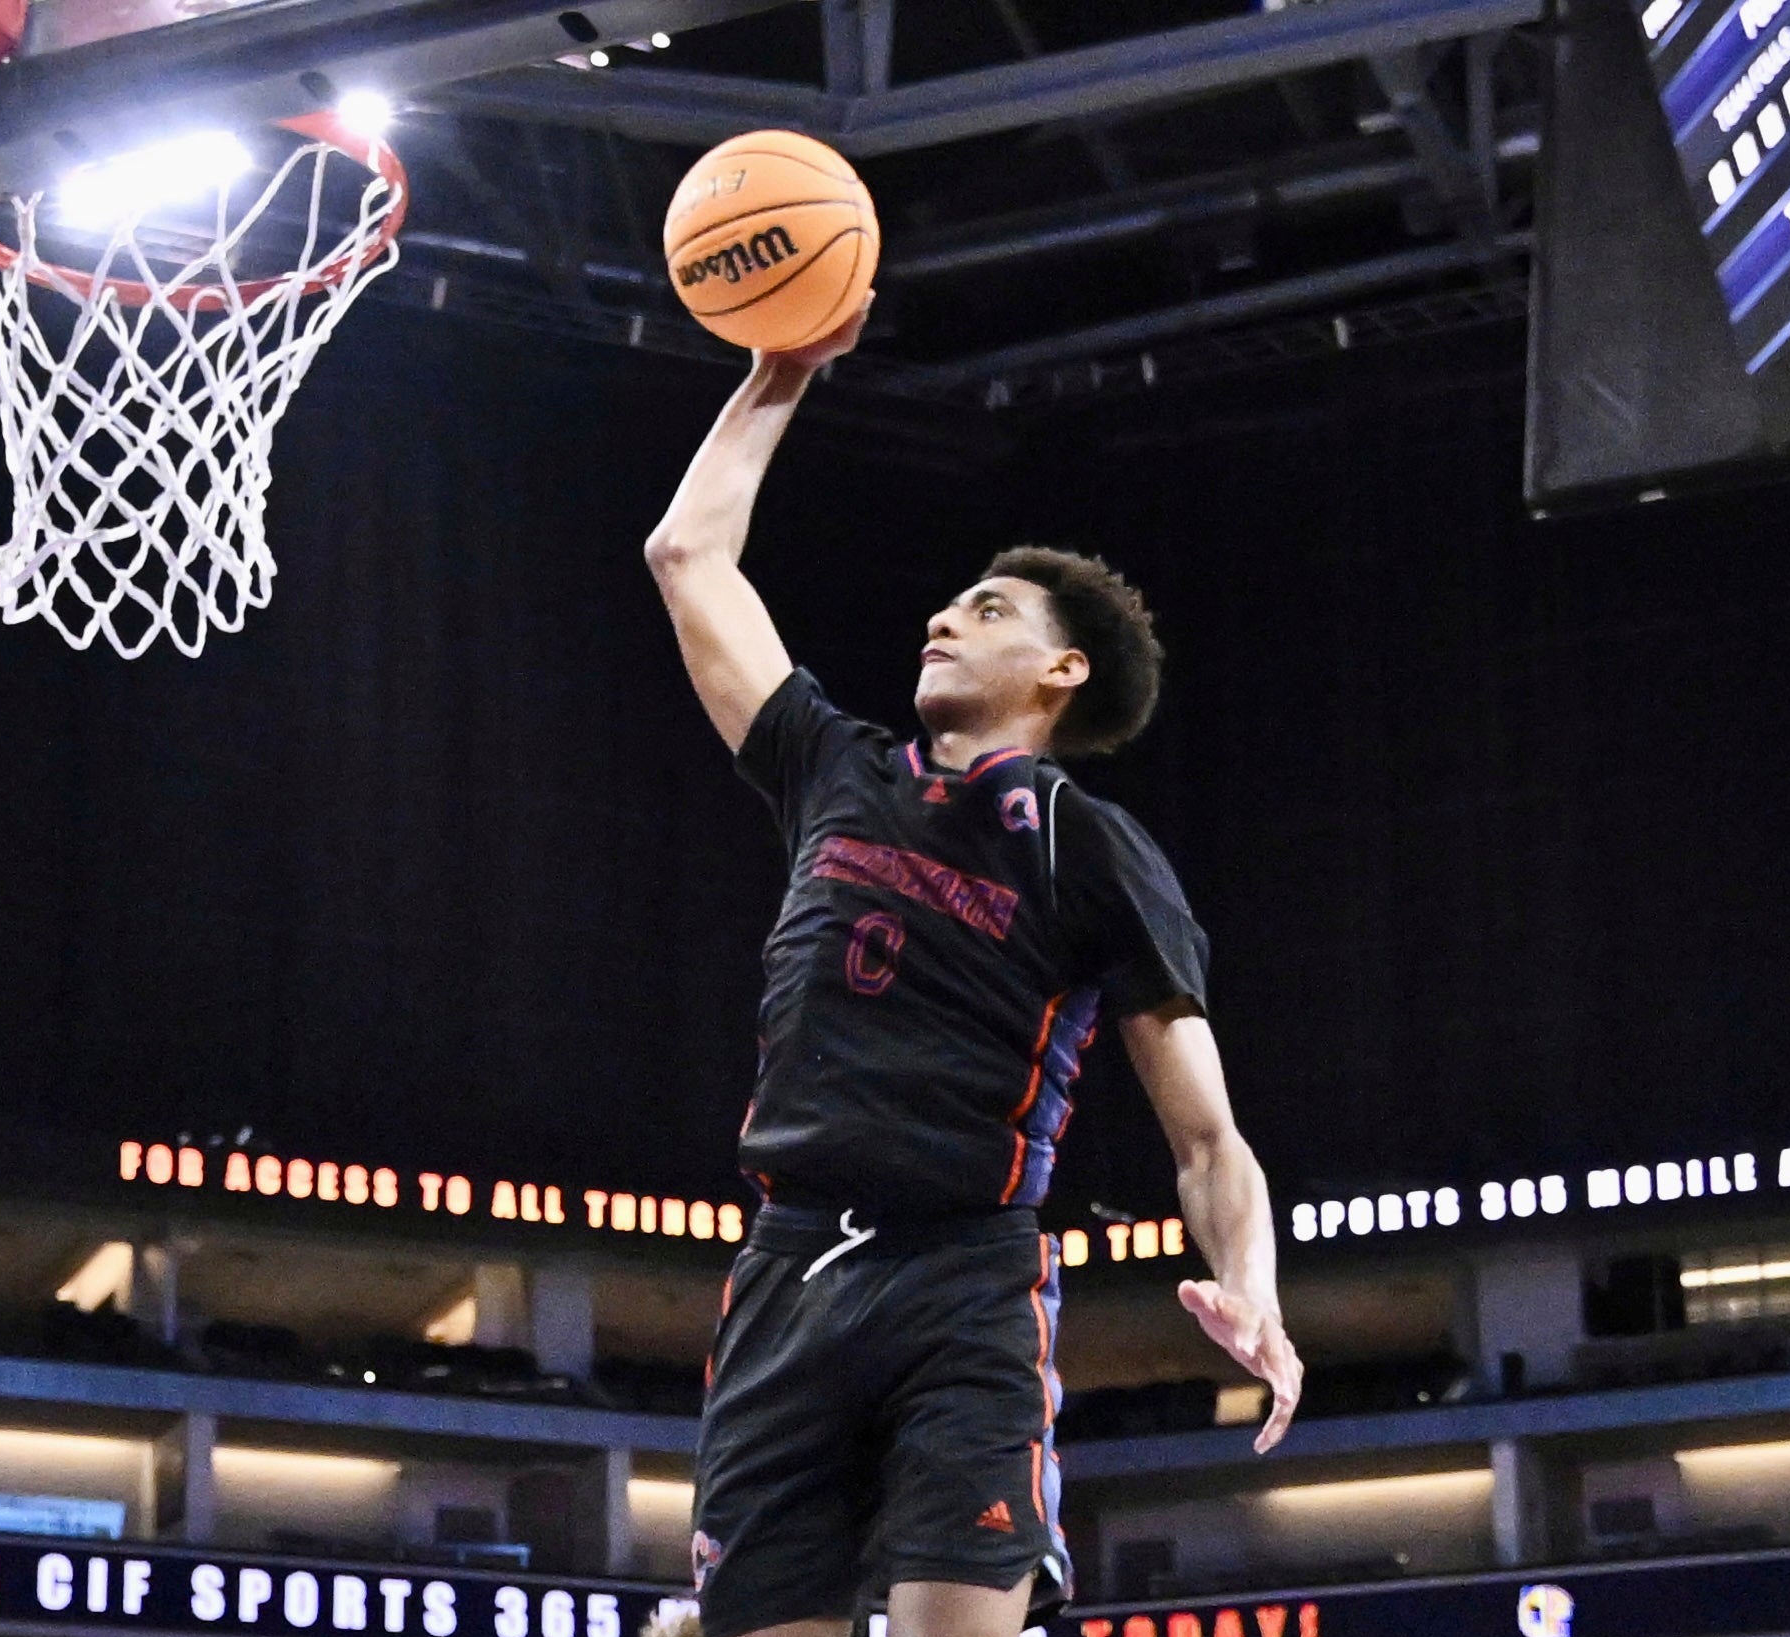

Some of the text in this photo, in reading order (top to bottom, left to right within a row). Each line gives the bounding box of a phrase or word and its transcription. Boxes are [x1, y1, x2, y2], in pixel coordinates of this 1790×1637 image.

[677, 224, 799, 287] Wilson
[120, 1141, 743, 1243] FOR ACCESS TO ALL THINGS
[1106, 1218, 1185, 1262] THE
[1293, 1186, 1461, 1242] SPORTS
[1479, 1174, 1568, 1221] 365
[1587, 1152, 1758, 1209] MOBILE
[37, 1552, 151, 1615] CIF
[191, 1563, 458, 1637] SPORTS
